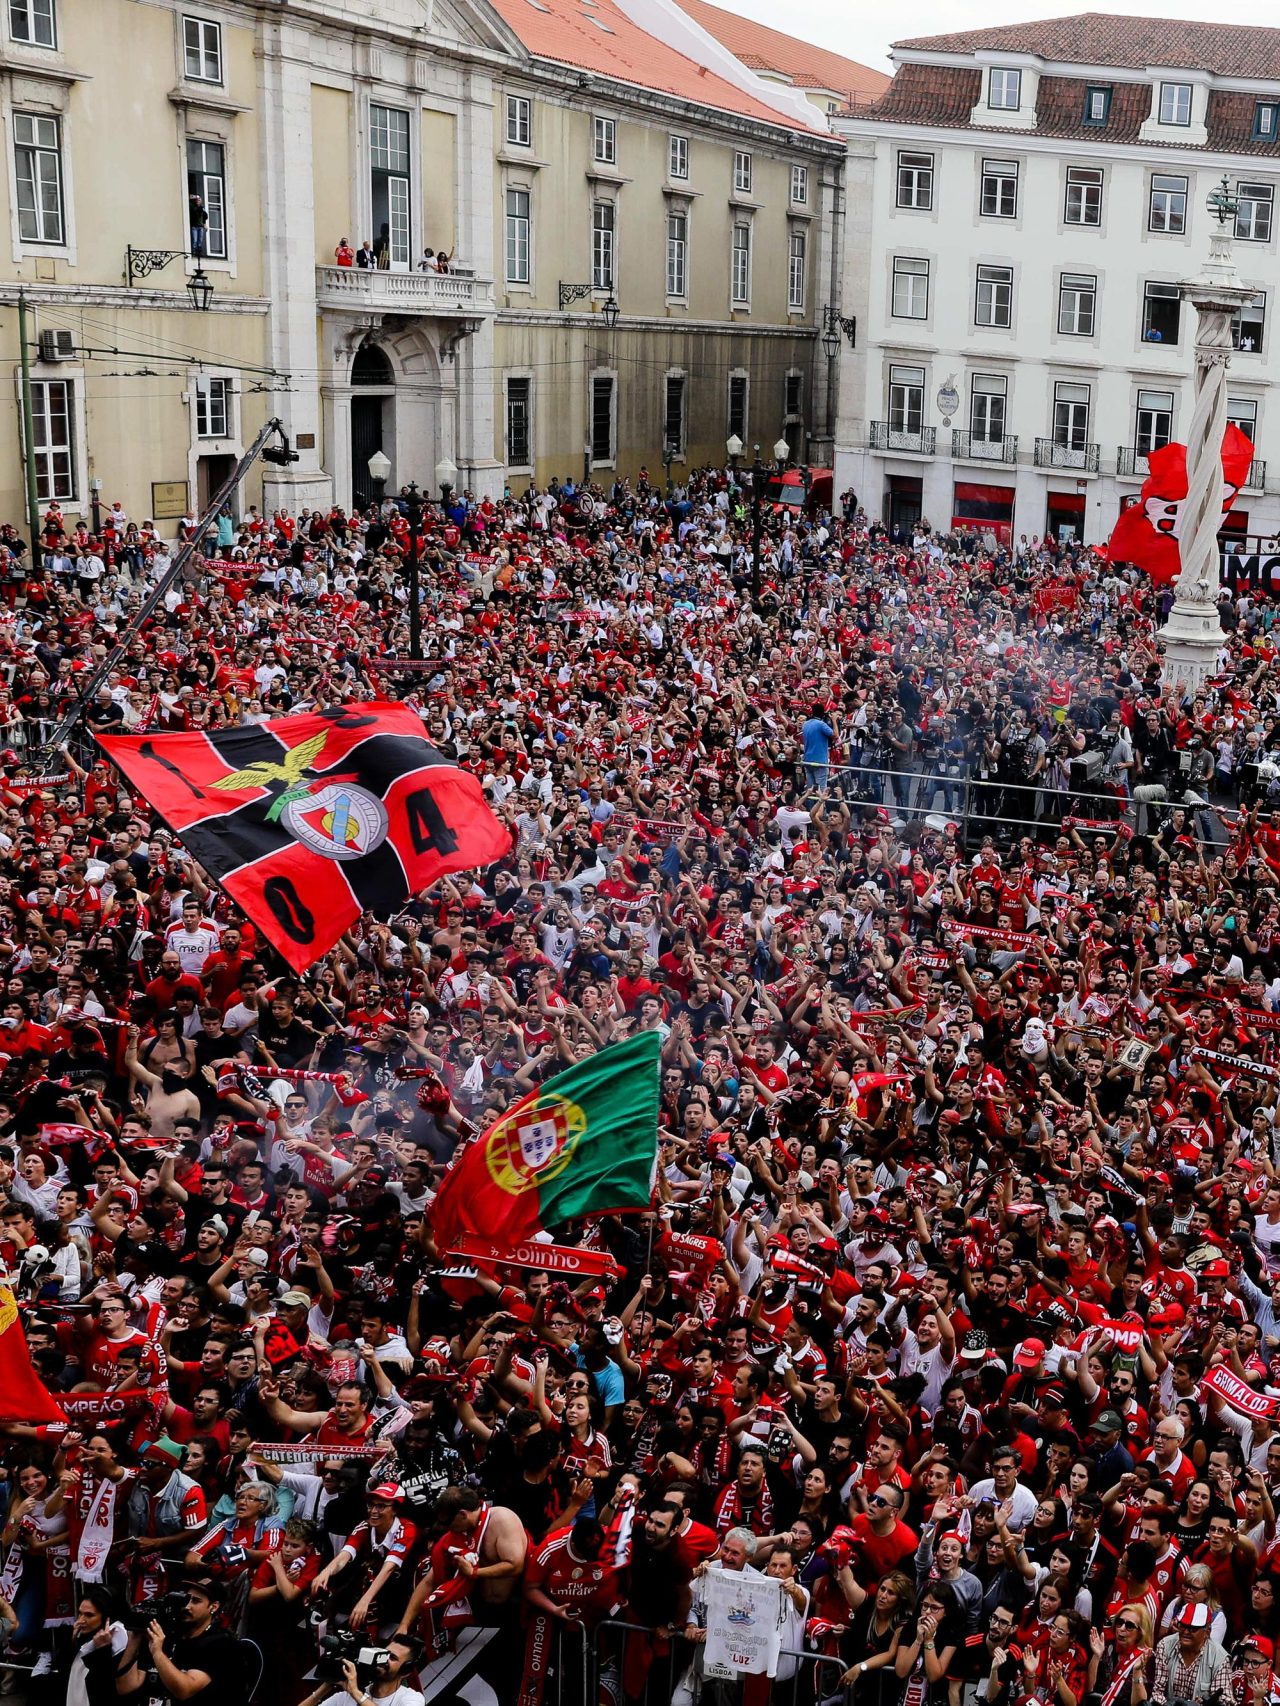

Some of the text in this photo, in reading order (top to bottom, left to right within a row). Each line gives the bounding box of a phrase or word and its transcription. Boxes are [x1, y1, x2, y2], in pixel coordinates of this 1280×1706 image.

[404, 787, 460, 857] 4
[179, 944, 205, 953] meo
[1244, 1011, 1274, 1025] TETRA
[679, 1233, 709, 1250] SAGRES
[1212, 1369, 1269, 1413] GRIMALDO
[715, 1479, 739, 1529] TETRA
[530, 1616, 546, 1672] ORGULHO
[708, 1667, 733, 1677] LISBOA
